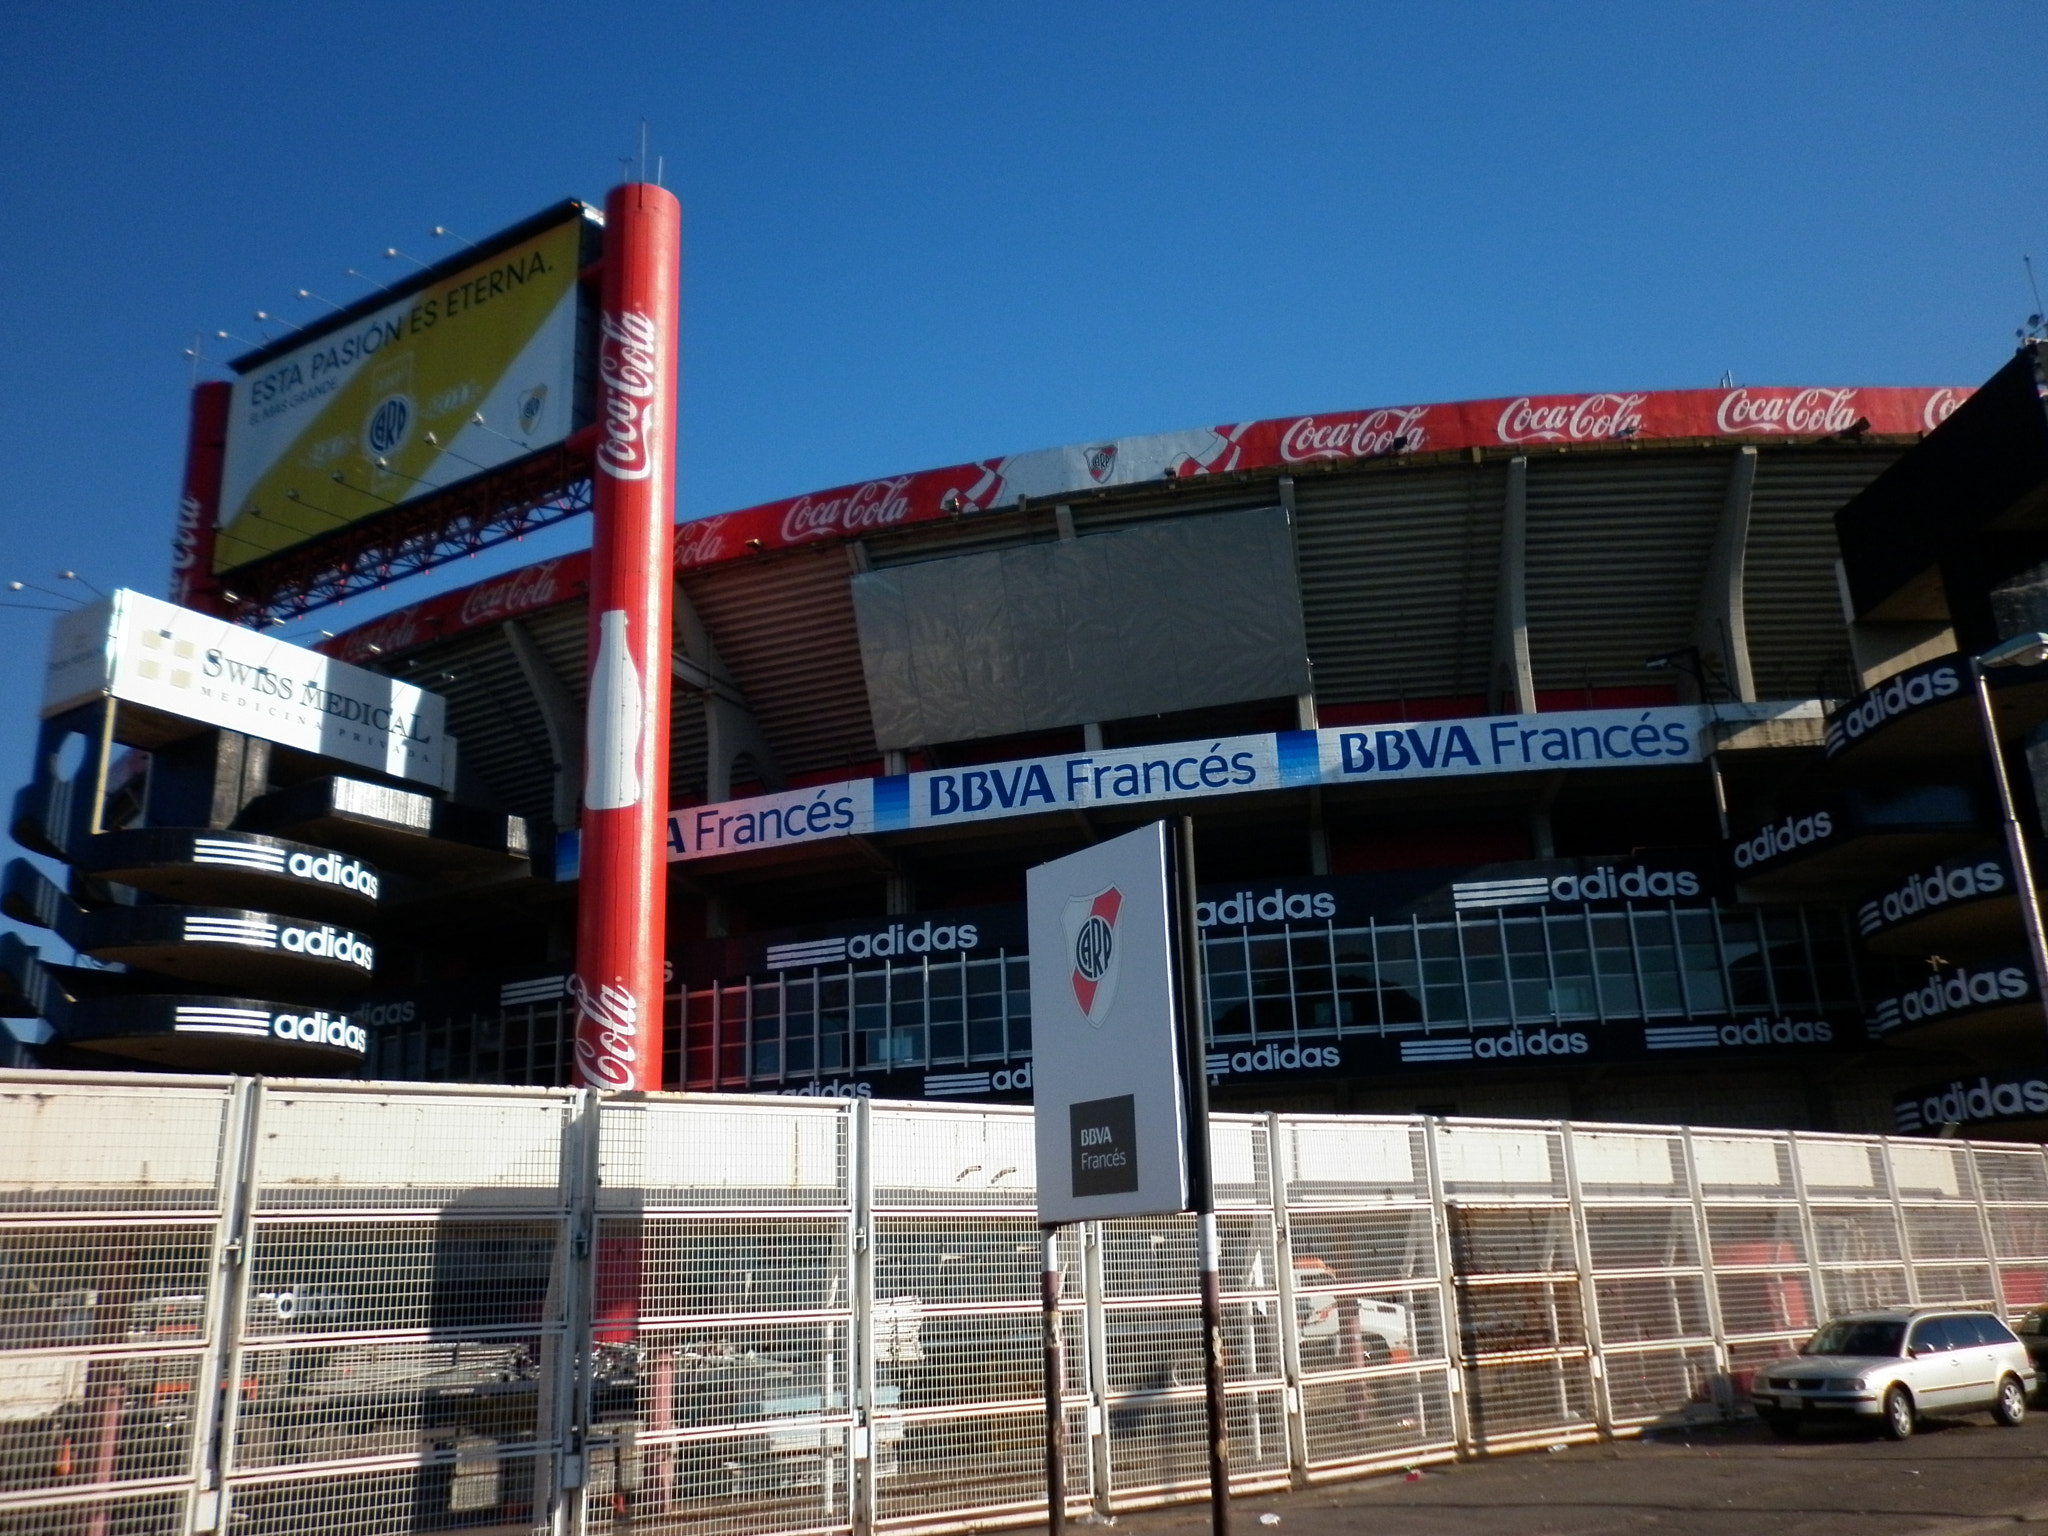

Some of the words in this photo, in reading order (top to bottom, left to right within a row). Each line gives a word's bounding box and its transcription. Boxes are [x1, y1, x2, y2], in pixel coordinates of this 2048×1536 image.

[251, 364, 304, 406] ESTA
[311, 316, 402, 380] PASIÓN
[409, 299, 438, 335] ES
[446, 251, 554, 318] ETERNA.
[1279, 406, 1430, 463] Coca-Cola
[1496, 393, 1648, 443] Coca-Cola
[1716, 387, 1859, 434] Coca-Cola
[780, 475, 915, 542] Coca-Cola
[202, 648, 293, 701] SWISS
[299, 684, 432, 745] MEDICAL
[1846, 666, 1960, 739] adidas
[200, 685, 324, 731] MEDICINA
[338, 727, 430, 763] PRIVADA
[1338, 725, 1482, 774] BBVA
[1489, 711, 1690, 765] Francés
[929, 764, 1056, 817] BBVA
[1066, 743, 1257, 802] Francés
[696, 789, 855, 851] Francés
[1734, 811, 1833, 869] adidas
[288, 852, 379, 900] adidas
[1551, 865, 1700, 902] adidas
[1883, 861, 2004, 922] adidas
[1196, 888, 1337, 927] adidas
[280, 925, 375, 971] adidas
[848, 920, 979, 960] adidas
[1902, 967, 2029, 1022] adidas
[273, 1010, 367, 1054] adidas
[1474, 1028, 1589, 1059] adidas
[1719, 1016, 1833, 1047] adidas
[992, 1062, 1032, 1091] ad
[1231, 1043, 1341, 1073] adidas
[1923, 1076, 2048, 1125] adidas
[1080, 1125, 1113, 1147] BBVA
[1080, 1148, 1127, 1171] Francés
